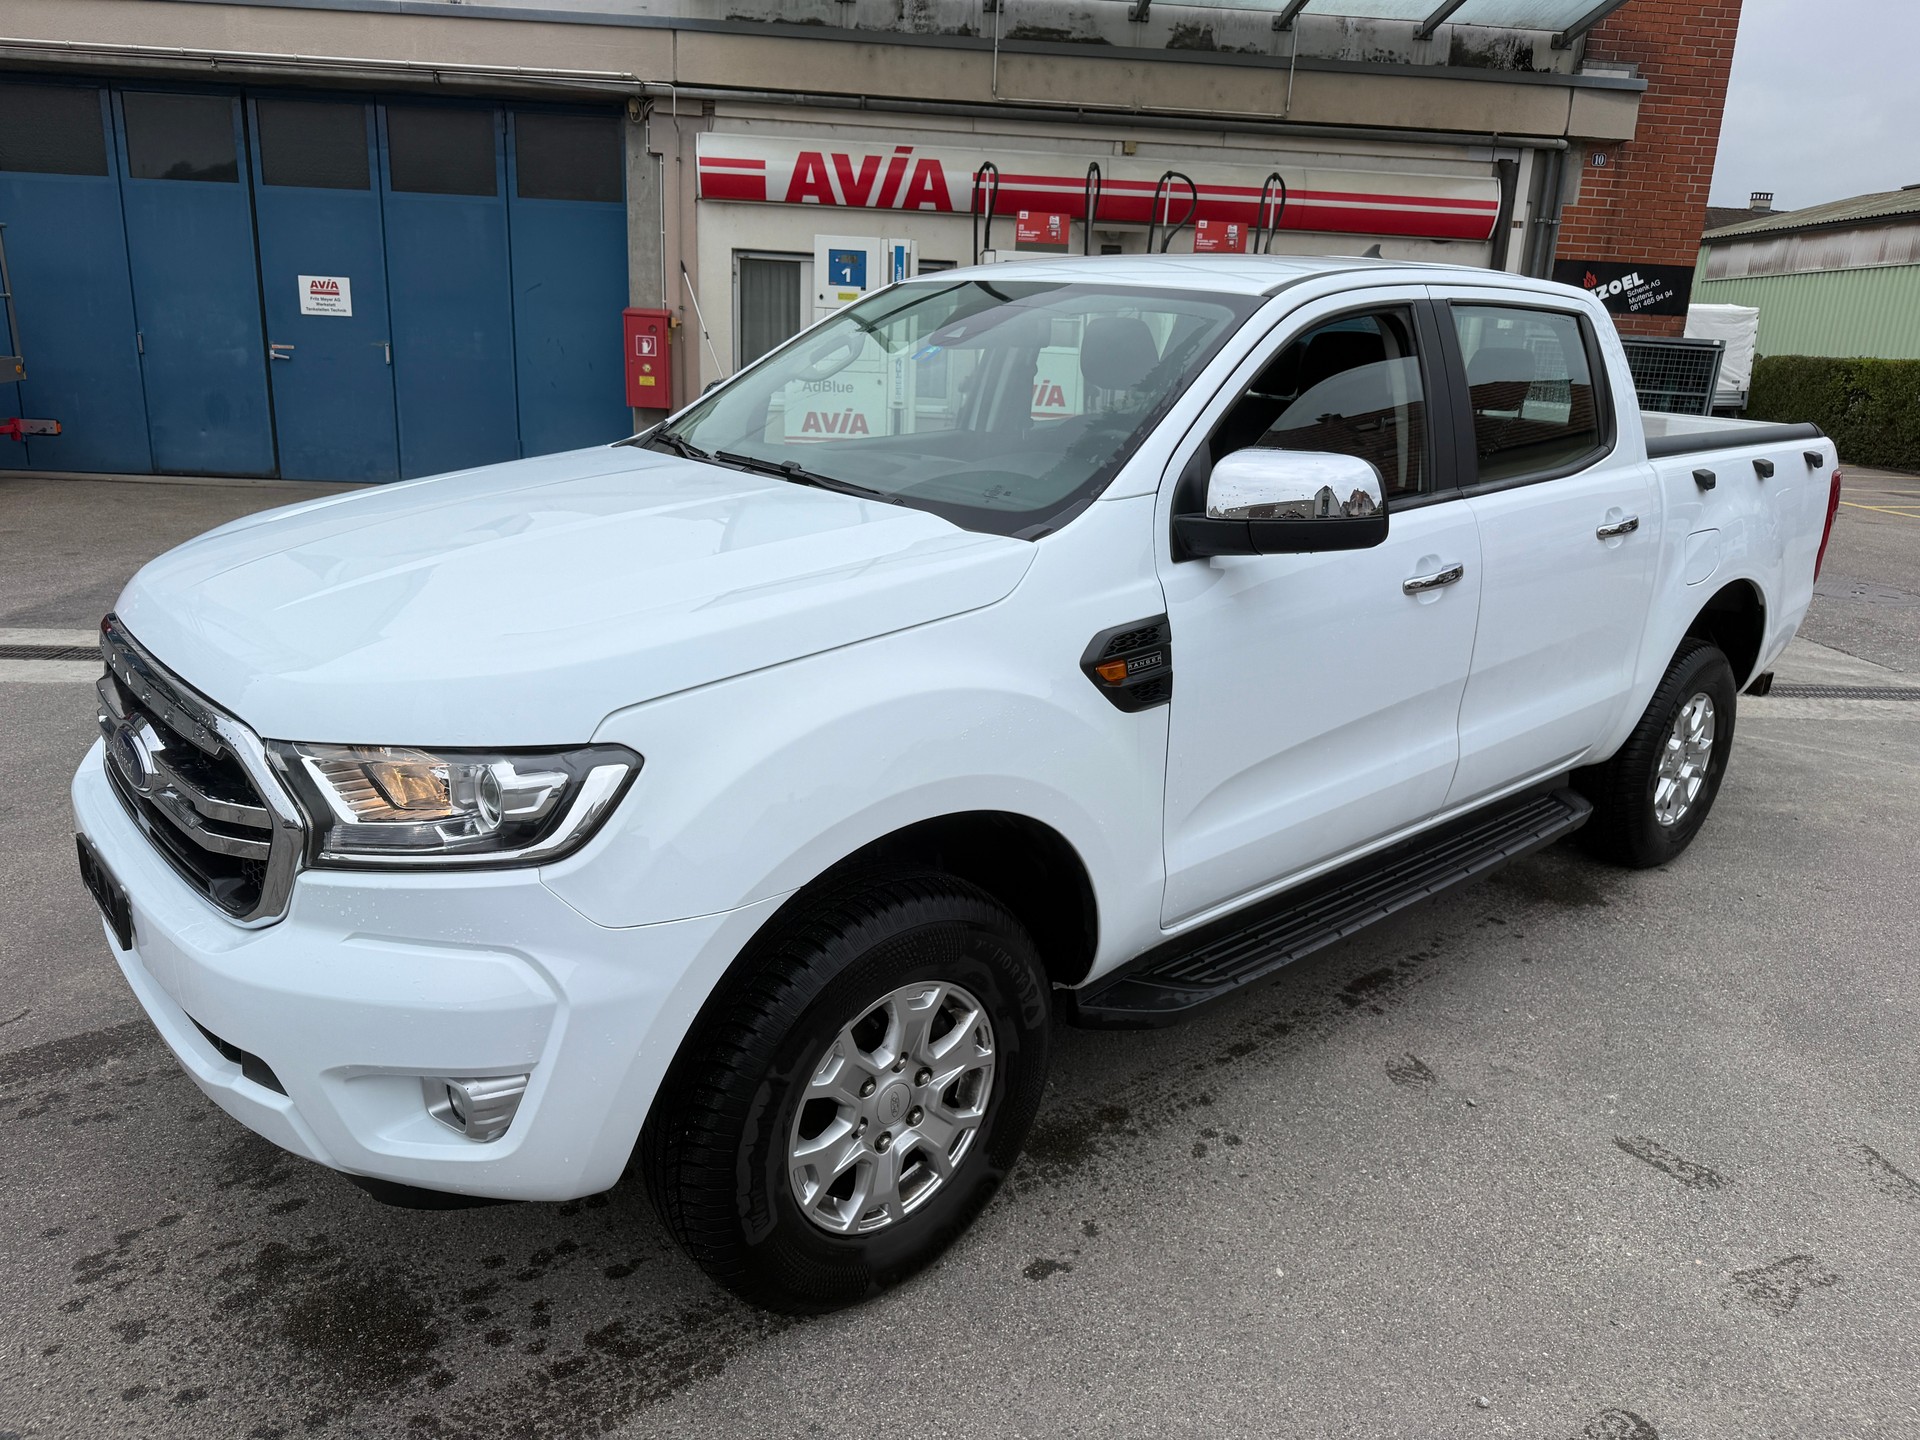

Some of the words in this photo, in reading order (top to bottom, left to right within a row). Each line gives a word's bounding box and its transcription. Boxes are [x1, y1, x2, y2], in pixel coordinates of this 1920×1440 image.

[1594, 154, 1604, 165] 10
[785, 146, 953, 211] AVIA
[841, 268, 851, 283] 1
[310, 278, 339, 290] AVIA
[1626, 283, 1650, 298] Schenk
[1650, 279, 1661, 289] AG
[1628, 291, 1653, 305] Muttenz
[1630, 302, 1642, 312] 061
[1655, 293, 1664, 302] 94
[1664, 289, 1673, 298] 94
[802, 380, 854, 393] AdBlue
[1033, 380, 1066, 407] IA
[801, 408, 870, 435] AVIA
[1128, 656, 1161, 669] RANGER
